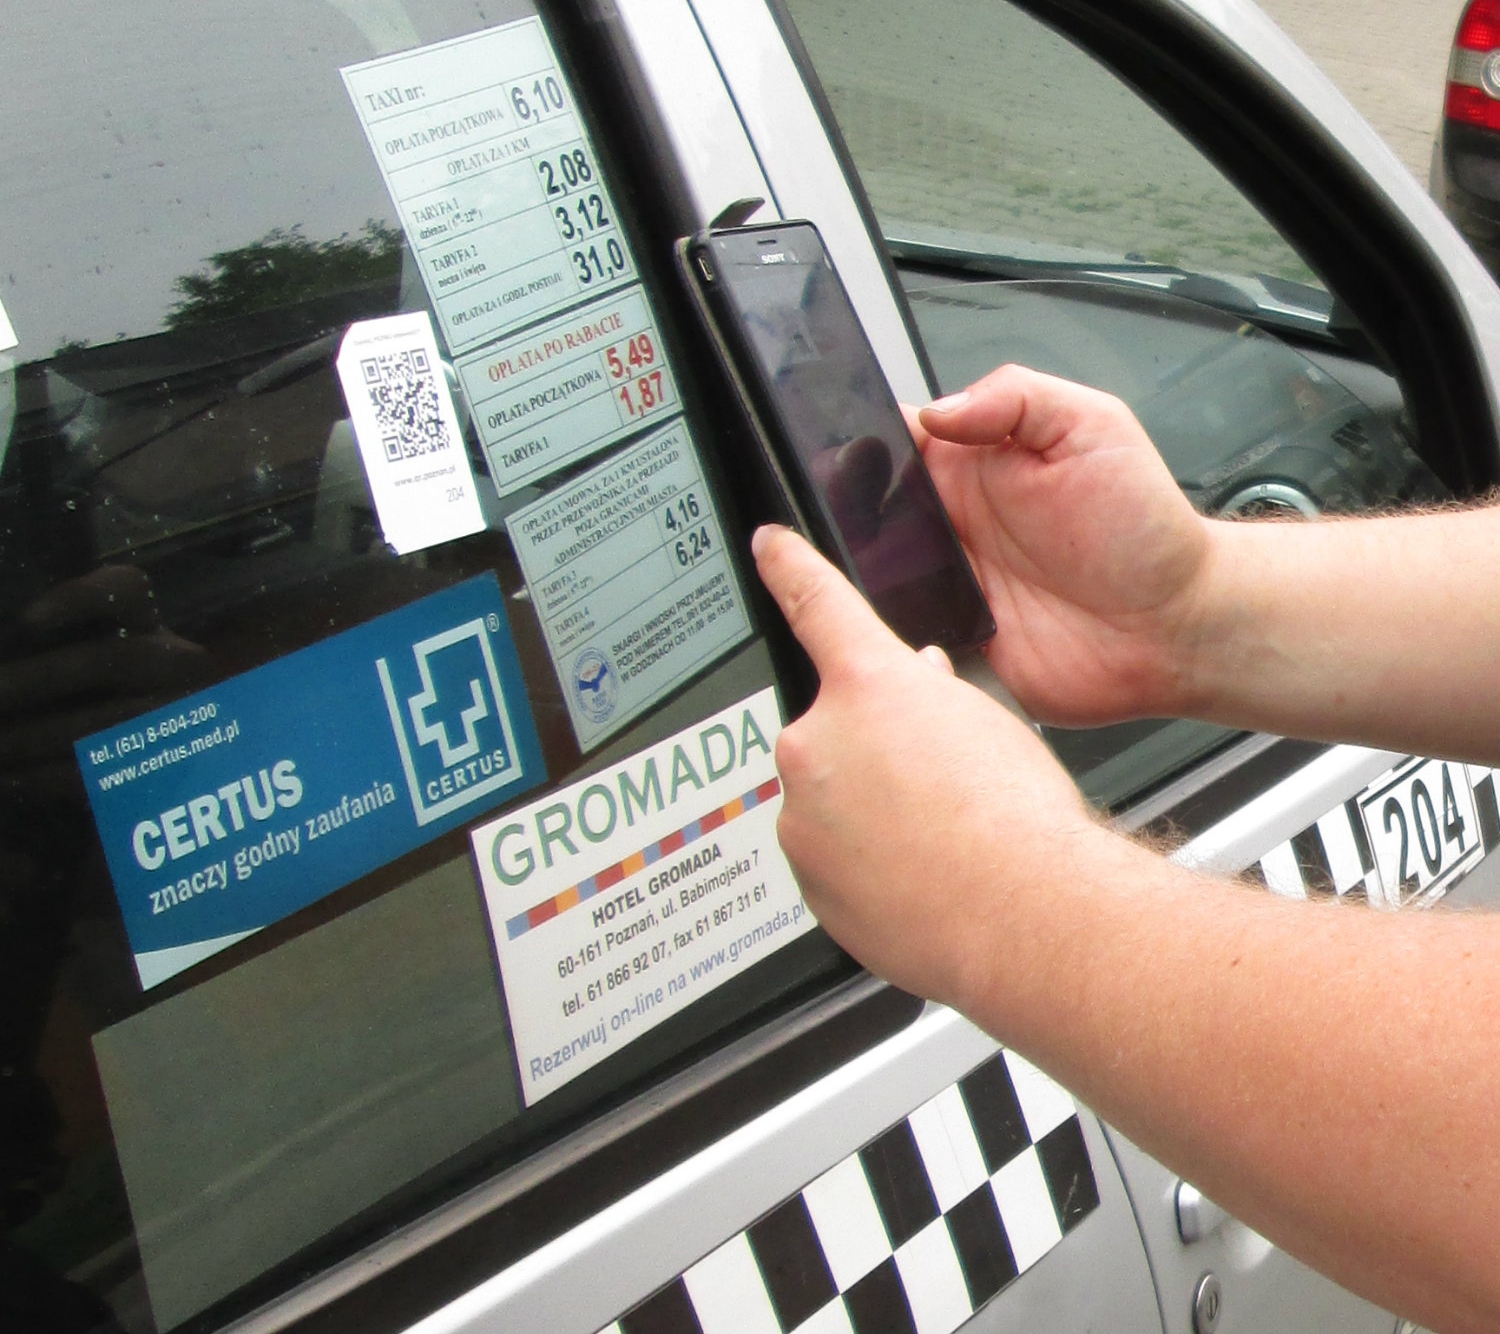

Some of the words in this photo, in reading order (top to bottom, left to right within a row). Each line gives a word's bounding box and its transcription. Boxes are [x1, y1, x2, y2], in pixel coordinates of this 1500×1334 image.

[365, 86, 404, 112] TAXI
[511, 75, 564, 124] 6,10
[538, 149, 592, 197] 2,08
[555, 193, 610, 242] 3,12
[431, 248, 472, 273] TARYFA
[572, 237, 625, 285] 31,0
[488, 350, 545, 383] OPŁATA
[543, 340, 565, 358] PO
[563, 312, 625, 351] RABACIE
[606, 333, 656, 380] 5,49
[487, 405, 531, 430] OPŁATA
[529, 370, 603, 409] POCZĄTKOWA
[620, 370, 665, 418] 1,87
[501, 440, 544, 468] TARYFA
[665, 492, 701, 534] 4,16
[675, 525, 712, 568] 6,24
[611, 629, 642, 657] SKARGI
[90, 746, 115, 767] tel.
[115, 731, 146, 759] (61)
[145, 702, 218, 745] 8-604-200
[98, 720, 241, 792] www.certus.med.pl
[426, 749, 507, 802] CERTUS
[491, 708, 773, 887] GROMADA
[131, 758, 304, 873] CERTUS
[1382, 761, 1466, 895] 204
[149, 860, 229, 916] znaczy
[233, 825, 301, 882] godny
[306, 781, 398, 842] zaufania
[592, 888, 647, 929] HOTEL
[648, 842, 723, 896] GROMADA
[557, 941, 603, 980] 60-161
[604, 910, 660, 954] Poznań,
[660, 901, 680, 922] ul.
[679, 859, 752, 912] Babimojska
[751, 848, 760, 869] 7
[562, 993, 586, 1018] tel.
[586, 977, 604, 1004] 61
[606, 963, 632, 994] 866
[634, 950, 651, 974] 92
[650, 939, 673, 965] 07,
[672, 924, 695, 952] fax
[695, 911, 711, 937] 61
[712, 898, 736, 929] 867
[737, 891, 753, 914] 31
[753, 881, 769, 905] 61
[528, 1021, 607, 1083] Rezerwuj
[610, 984, 666, 1034] on-line
[667, 971, 688, 996] na
[688, 898, 807, 983] www.gromada.pl
